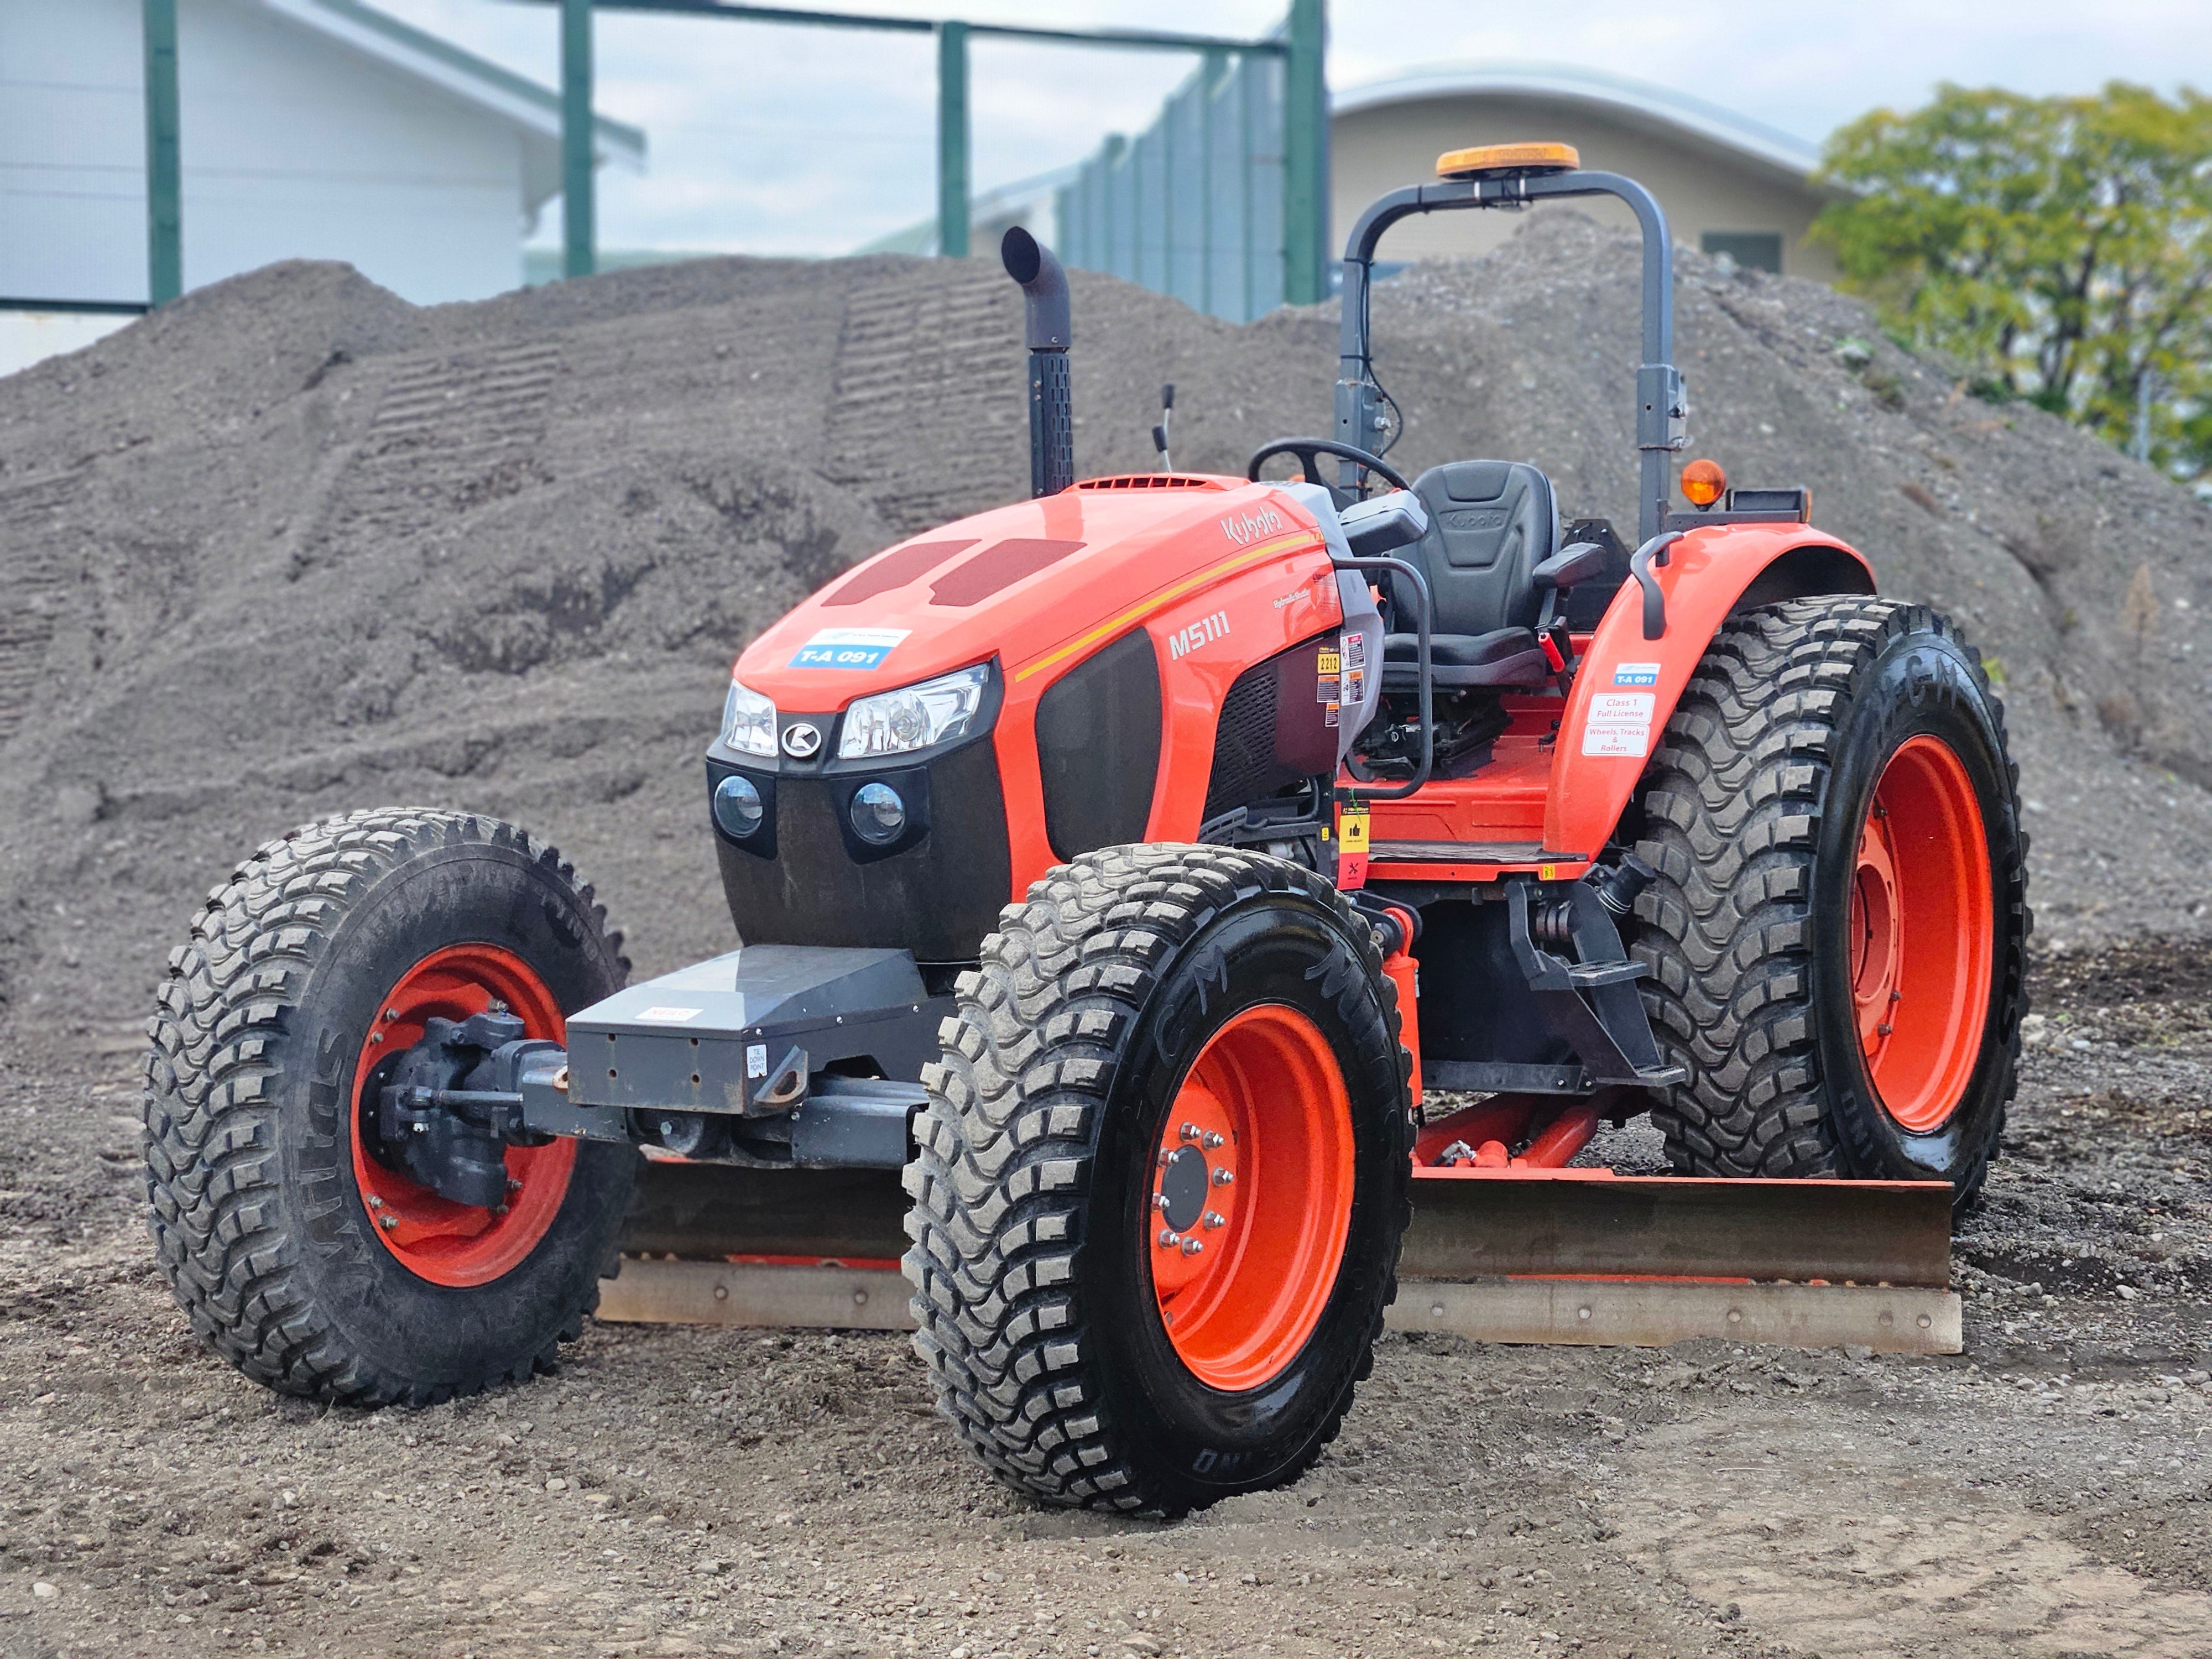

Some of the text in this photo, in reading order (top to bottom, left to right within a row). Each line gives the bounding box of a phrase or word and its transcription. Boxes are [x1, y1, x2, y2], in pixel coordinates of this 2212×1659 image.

[1219, 505, 1284, 546] Kubota
[1168, 610, 1230, 661] M5111
[800, 650, 880, 664] T-A 091
[1321, 656, 1337, 670] 2212
[1617, 675, 1653, 684] T-A 091
[749, 1055, 765, 1063] DOWN
[750, 1063, 764, 1071] POINT
